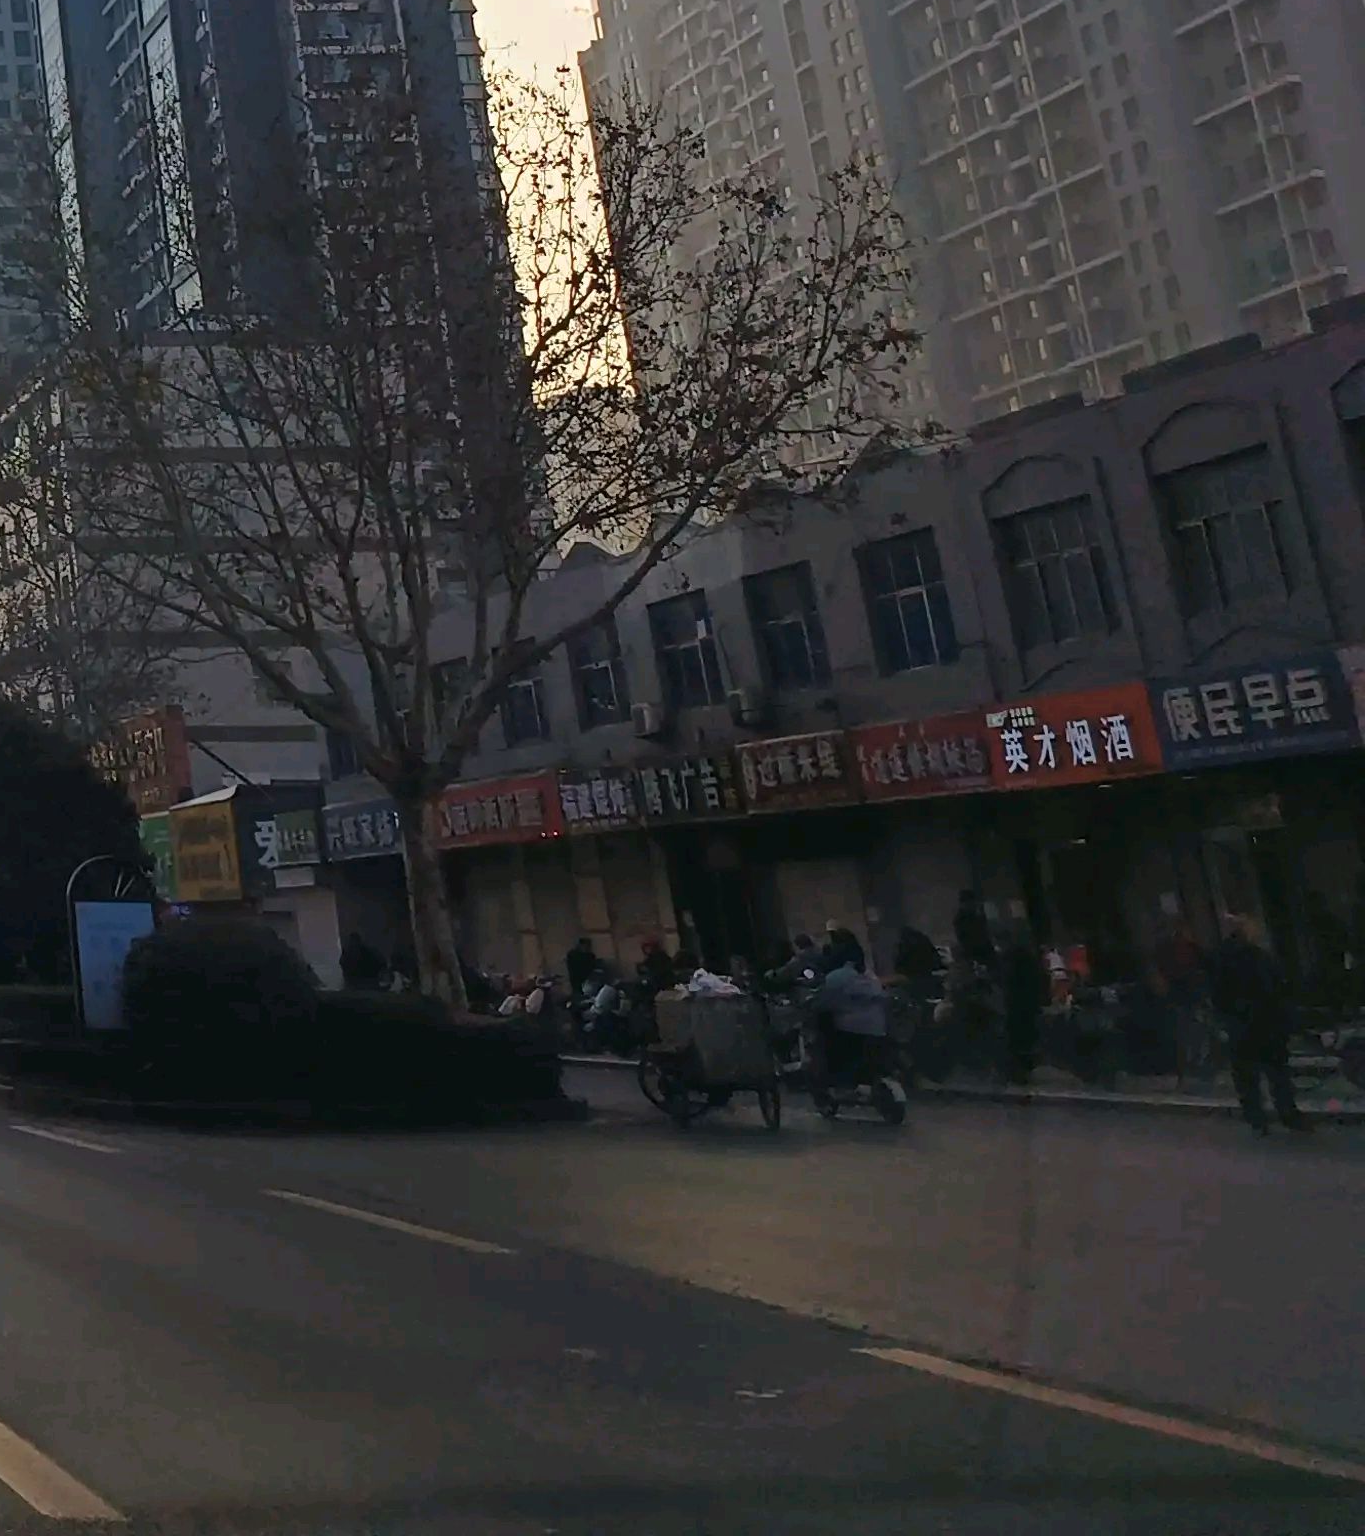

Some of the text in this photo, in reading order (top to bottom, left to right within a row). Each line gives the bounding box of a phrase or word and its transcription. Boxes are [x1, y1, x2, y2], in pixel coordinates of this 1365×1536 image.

[1163, 668, 1332, 742] 便民早点
[1001, 714, 1134, 773] 英才烟酒
